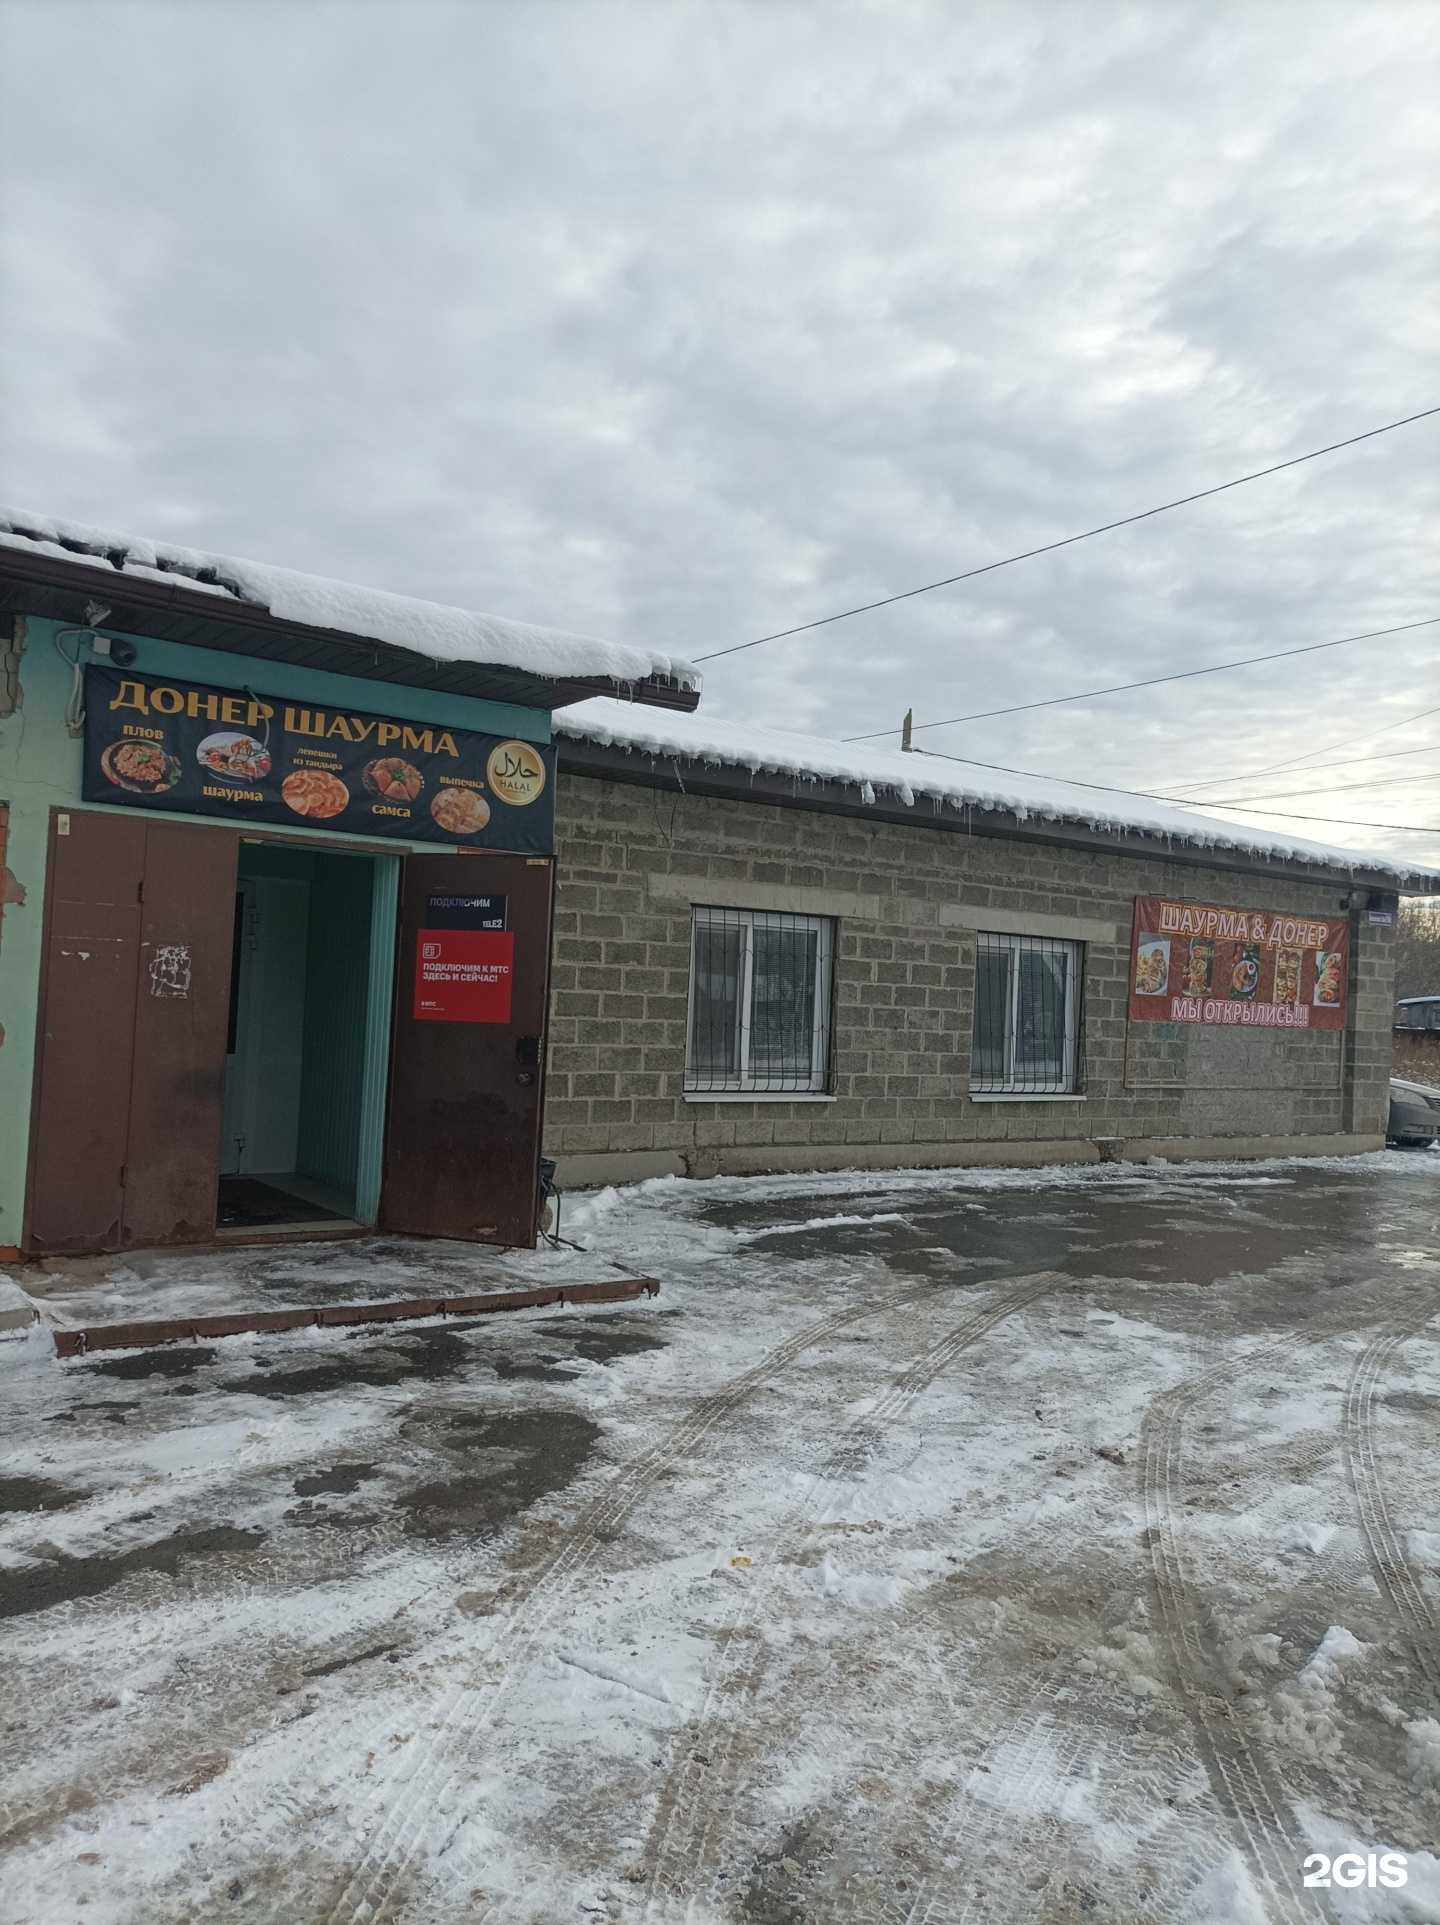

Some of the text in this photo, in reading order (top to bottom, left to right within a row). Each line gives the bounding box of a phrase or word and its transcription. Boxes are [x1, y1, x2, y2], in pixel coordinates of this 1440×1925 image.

[110, 681, 460, 758] ДОНЕР ШАУРМА
[122, 724, 165, 741] плов
[495, 752, 539, 778] حلال
[203, 785, 264, 802] шаурма
[501, 779, 532, 792] HALAL
[372, 803, 411, 818] самса
[1159, 903, 1329, 950] ШАУРМА & ДОНЕР
[423, 963, 509, 974] ПОДКЛЮЧИМ К МТС
[423, 972, 498, 982] ЗДЕСЬ И СЕЙЧАС!
[1171, 997, 1310, 1028] МЫ ОТКРЫЛИСЬ!!!
